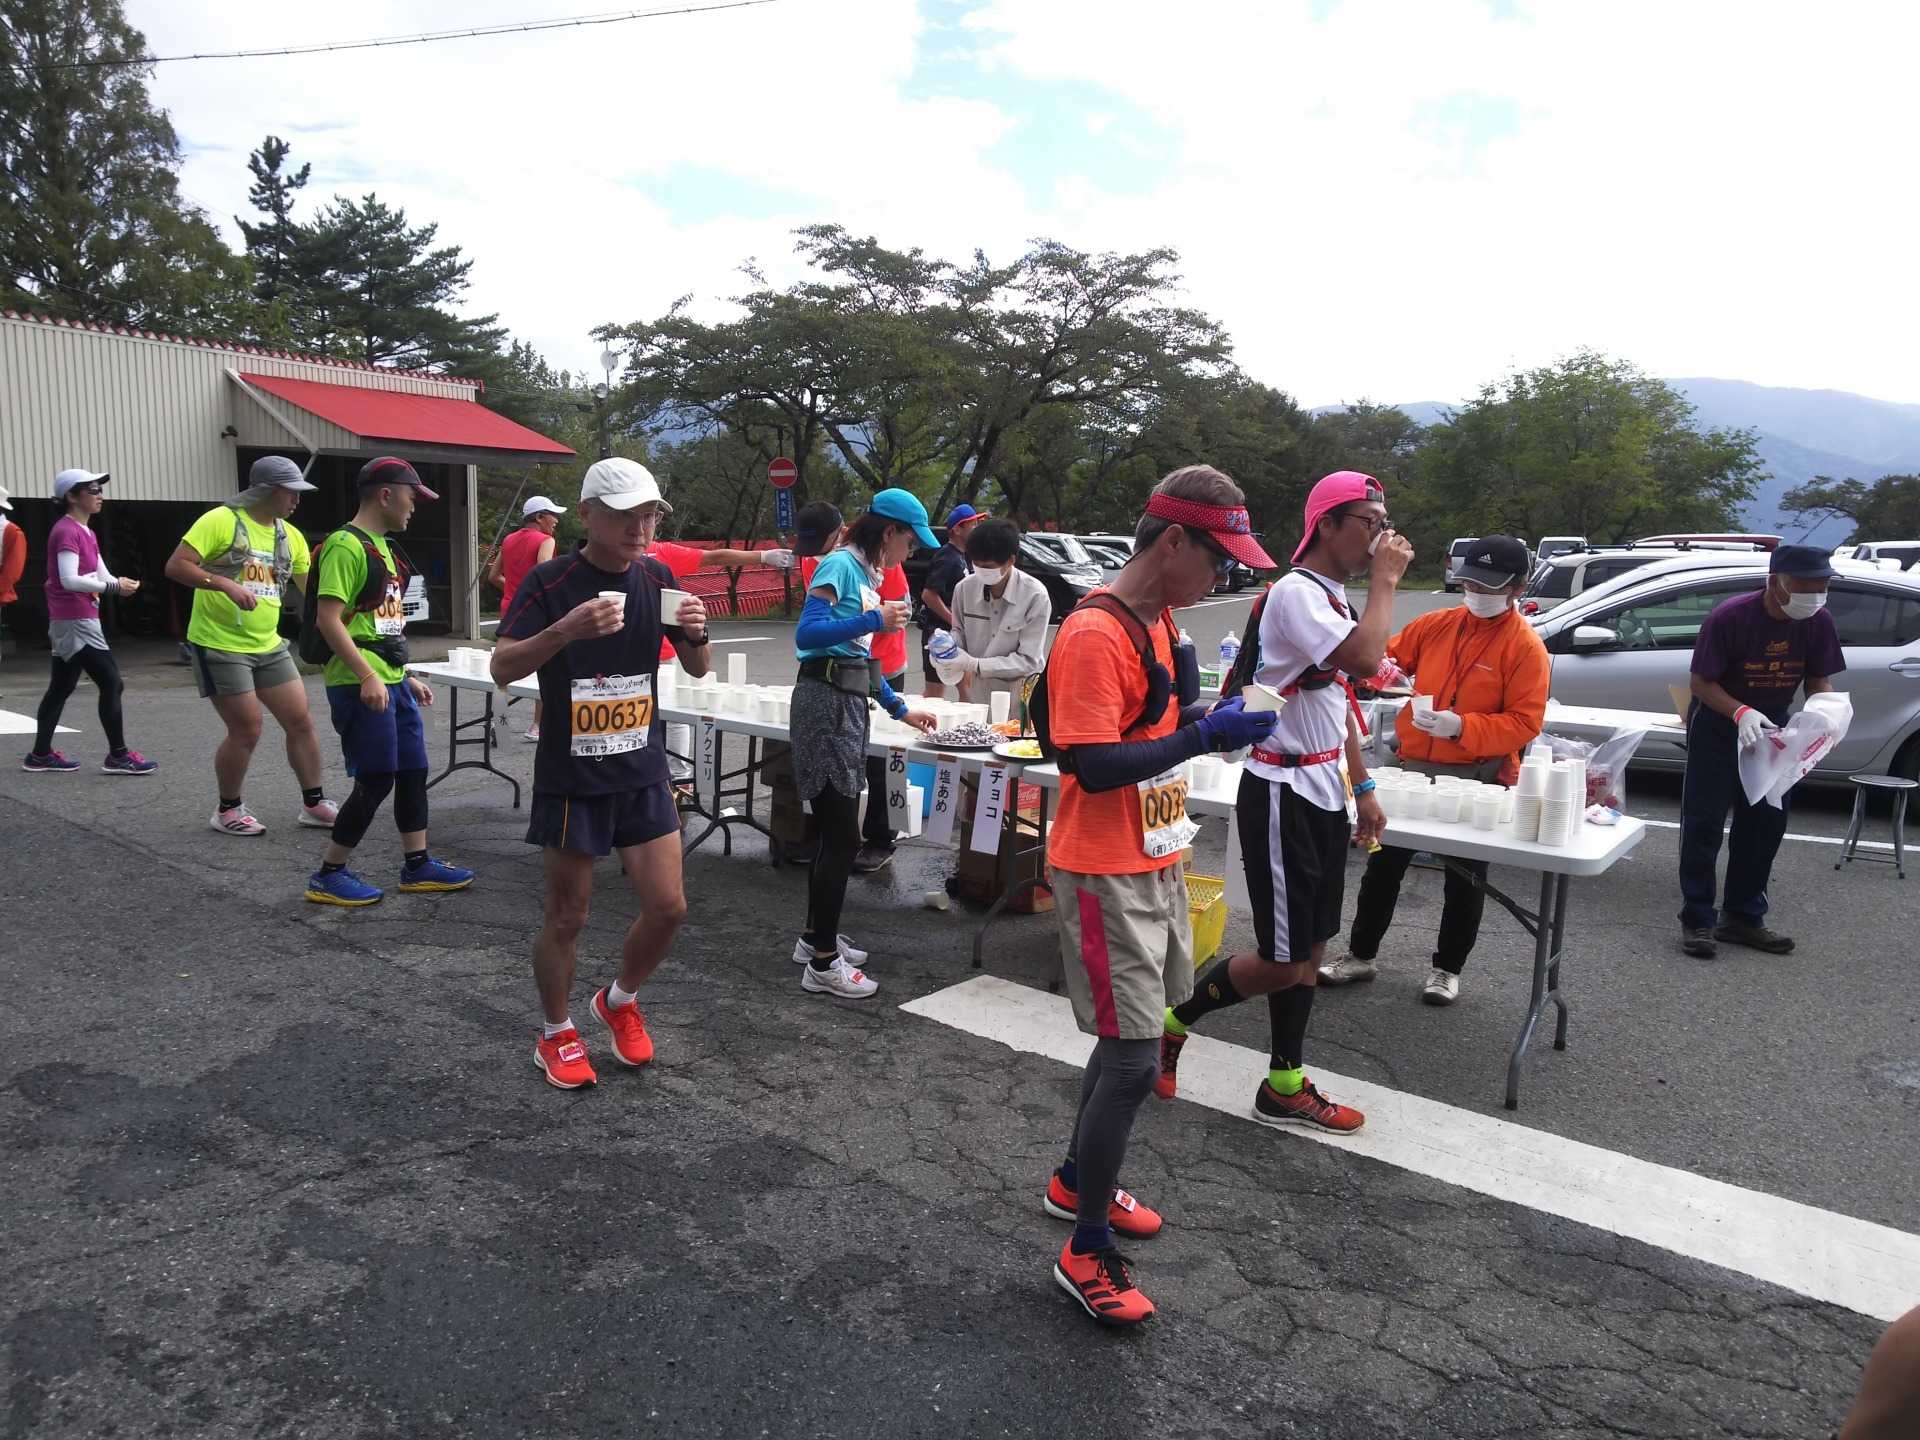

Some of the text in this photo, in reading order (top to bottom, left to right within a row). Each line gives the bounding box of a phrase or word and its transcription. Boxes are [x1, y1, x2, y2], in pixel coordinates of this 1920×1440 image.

[576, 698, 649, 732] 00637
[703, 723, 714, 781] アクエリ
[1319, 752, 1332, 761] TYR
[889, 751, 905, 809] あめ
[935, 769, 951, 813] 塩あめ
[986, 770, 1004, 819] チョコ
